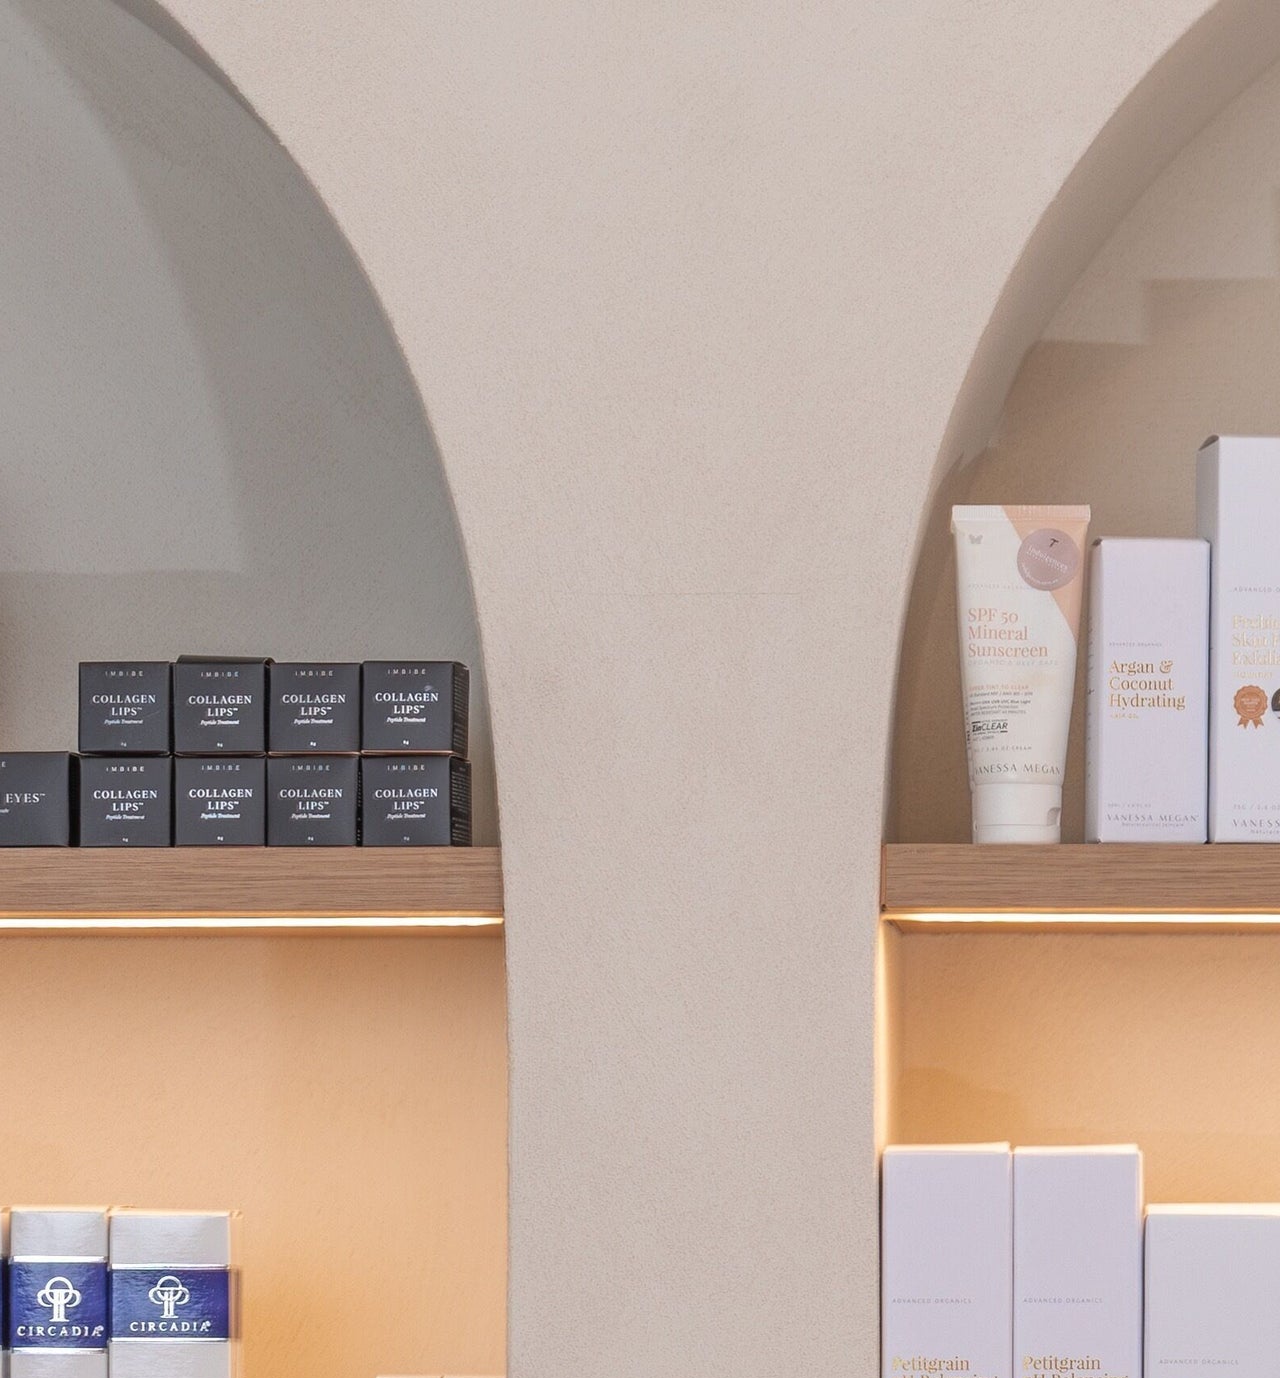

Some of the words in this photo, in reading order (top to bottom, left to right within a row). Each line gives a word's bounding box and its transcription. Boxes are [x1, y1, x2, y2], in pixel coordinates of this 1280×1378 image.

[968, 608, 997, 624] SPF
[1001, 611, 1019, 625] 50
[968, 626, 1029, 641] Mineral
[968, 643, 1048, 658] Sunscreen
[1109, 660, 1155, 676] Argan
[1160, 660, 1174, 674] &
[1109, 677, 1173, 691] Coconut
[93, 694, 156, 704] COLLAGEN
[282, 694, 346, 704] COLLAGEN
[1109, 693, 1186, 711] Hydrating
[94, 789, 158, 800] COLLAGEN
[892, 1357, 970, 1372] Petitgrain
[1023, 1356, 1101, 1371] Petitgrain
